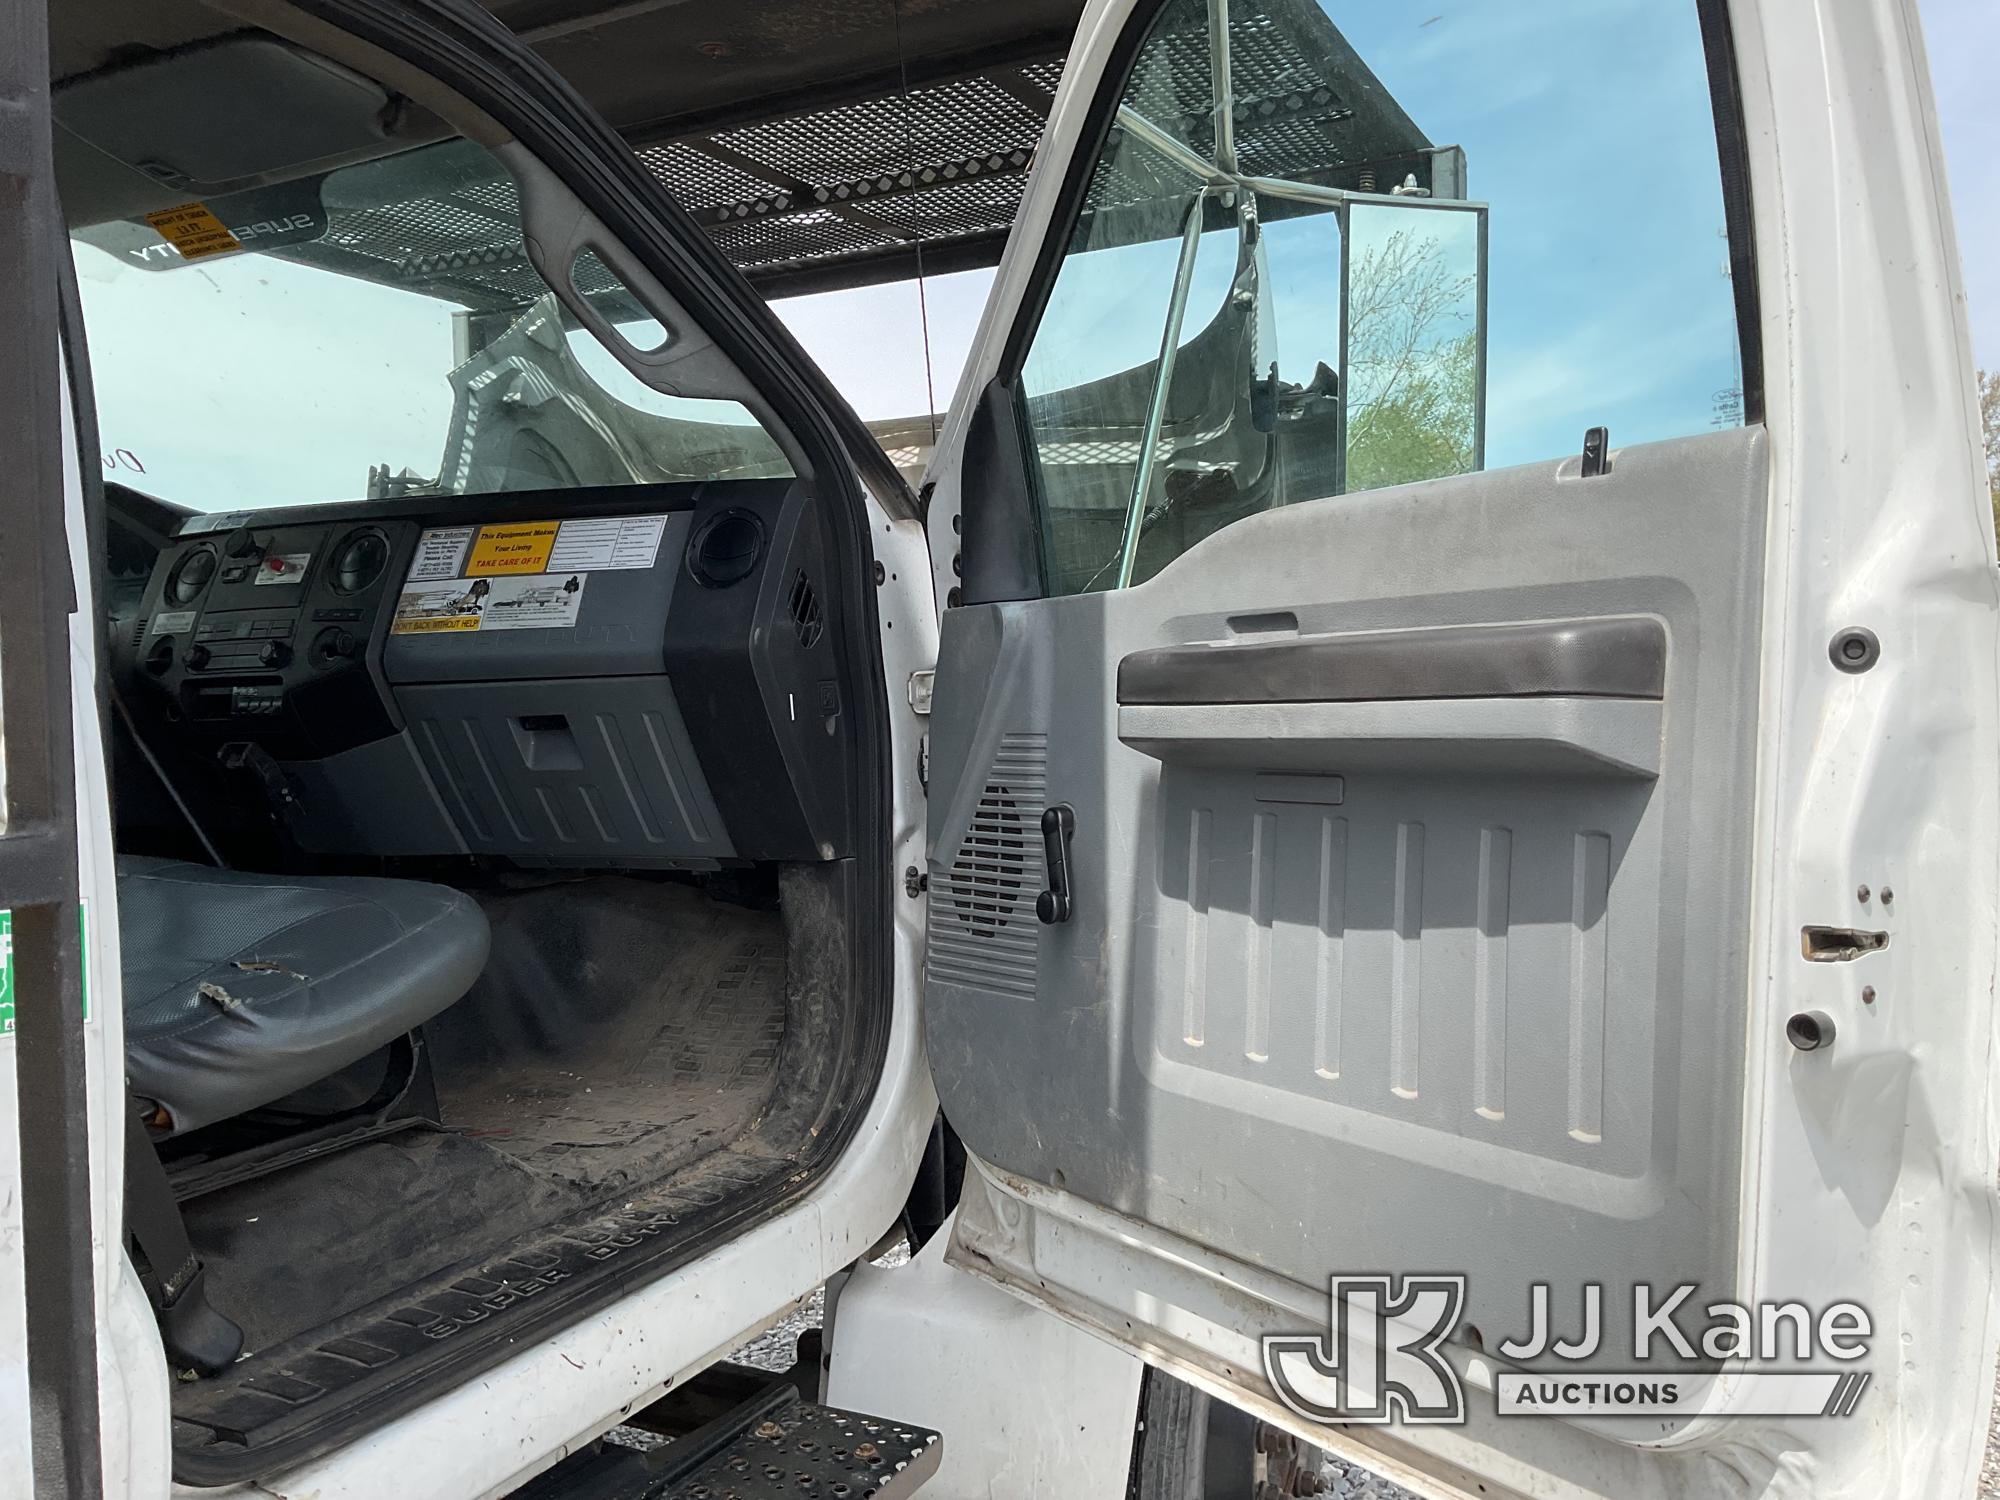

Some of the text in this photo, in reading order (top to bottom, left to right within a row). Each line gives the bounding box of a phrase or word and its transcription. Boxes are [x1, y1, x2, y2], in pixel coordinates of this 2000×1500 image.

[496, 530, 532, 540] Equipment
[511, 544, 532, 552] Living
[476, 559, 498, 568] TAKE
[498, 558, 520, 566] CARE
[520, 557, 532, 565] OF
[432, 619, 460, 629] WITHOUT
[422, 1268, 573, 1340] SUPER
